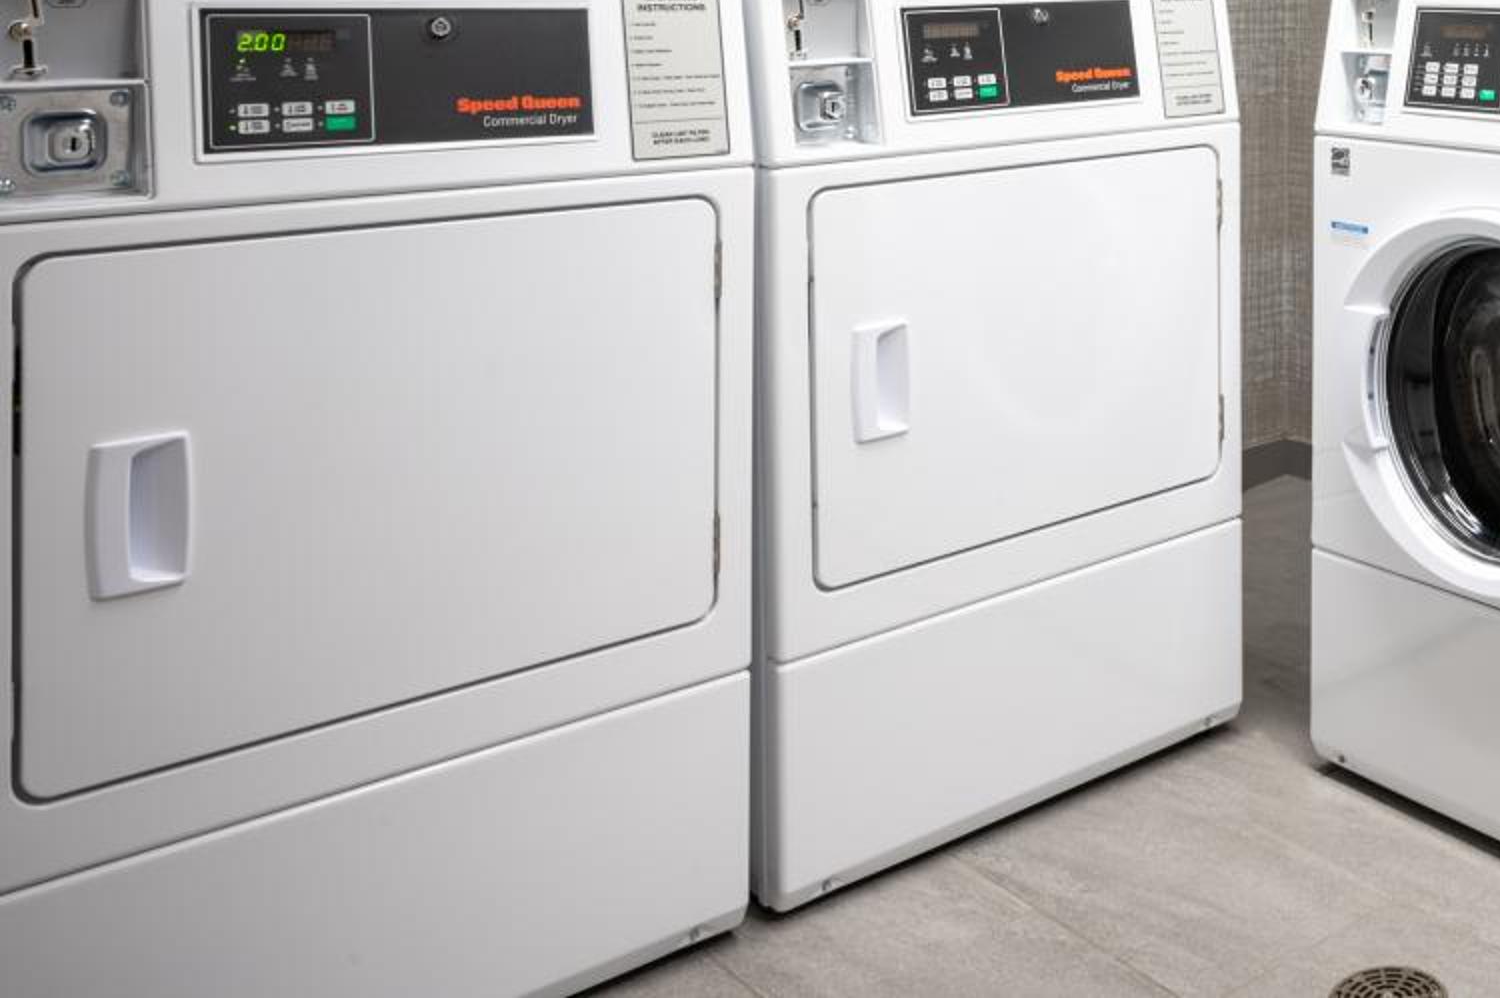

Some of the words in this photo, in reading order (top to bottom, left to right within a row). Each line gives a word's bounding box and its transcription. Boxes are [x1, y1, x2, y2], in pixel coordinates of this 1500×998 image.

[638, 3, 706, 11] INSTRUCTIONS
[1056, 68, 1092, 82] Speed
[1094, 67, 1131, 79] Queen
[1071, 80, 1110, 92] Commercial
[457, 96, 519, 114] Speed
[521, 94, 581, 109] Queen
[483, 114, 547, 127] Commercial
[549, 113, 577, 126] Dryer
